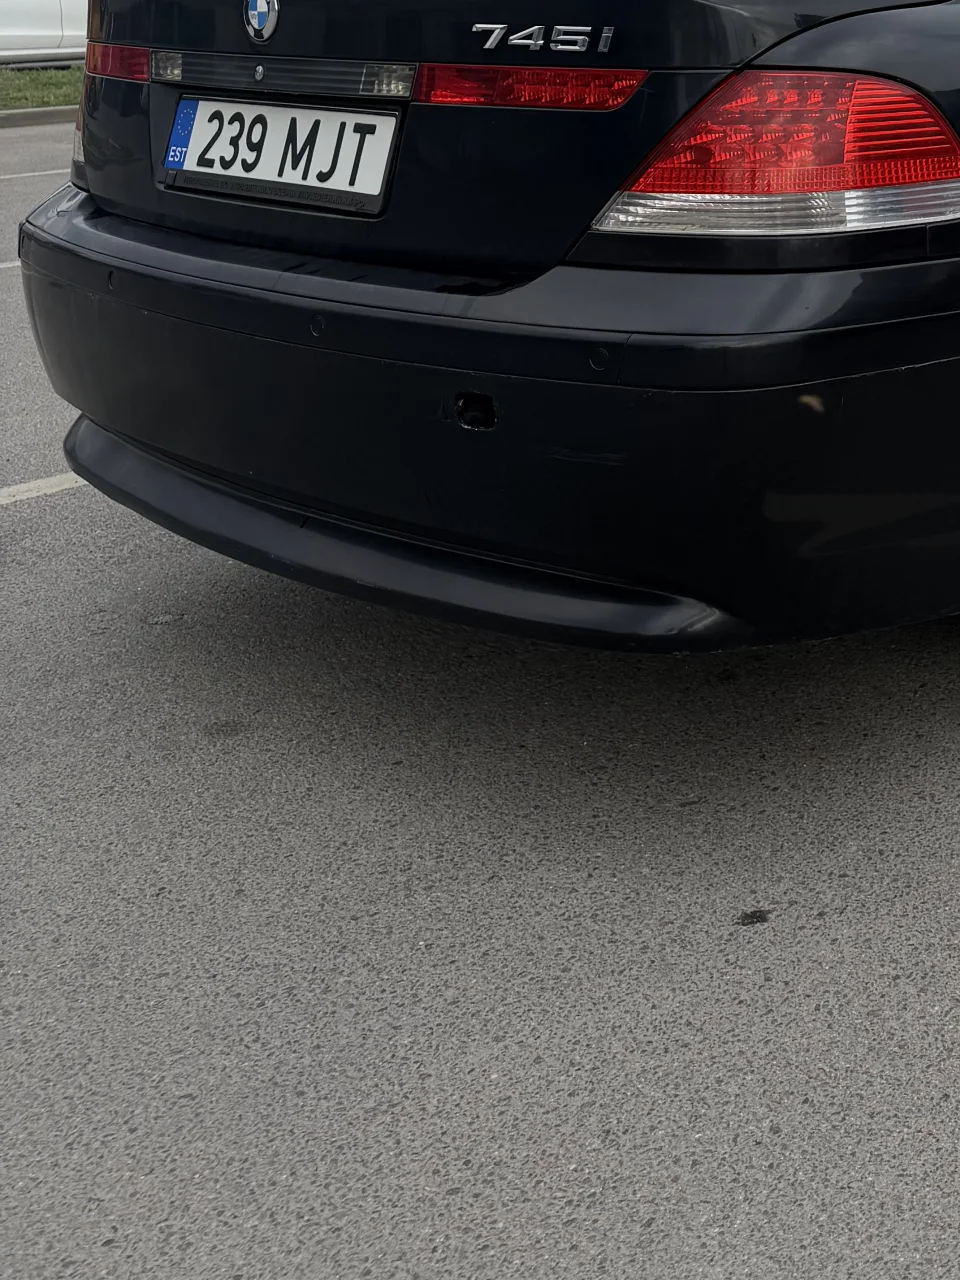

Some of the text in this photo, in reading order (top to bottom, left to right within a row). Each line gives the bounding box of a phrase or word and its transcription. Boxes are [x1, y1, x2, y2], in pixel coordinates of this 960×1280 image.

[471, 23, 615, 53] 745i
[168, 146, 188, 163] EST
[196, 109, 377, 187] 239 MJT
